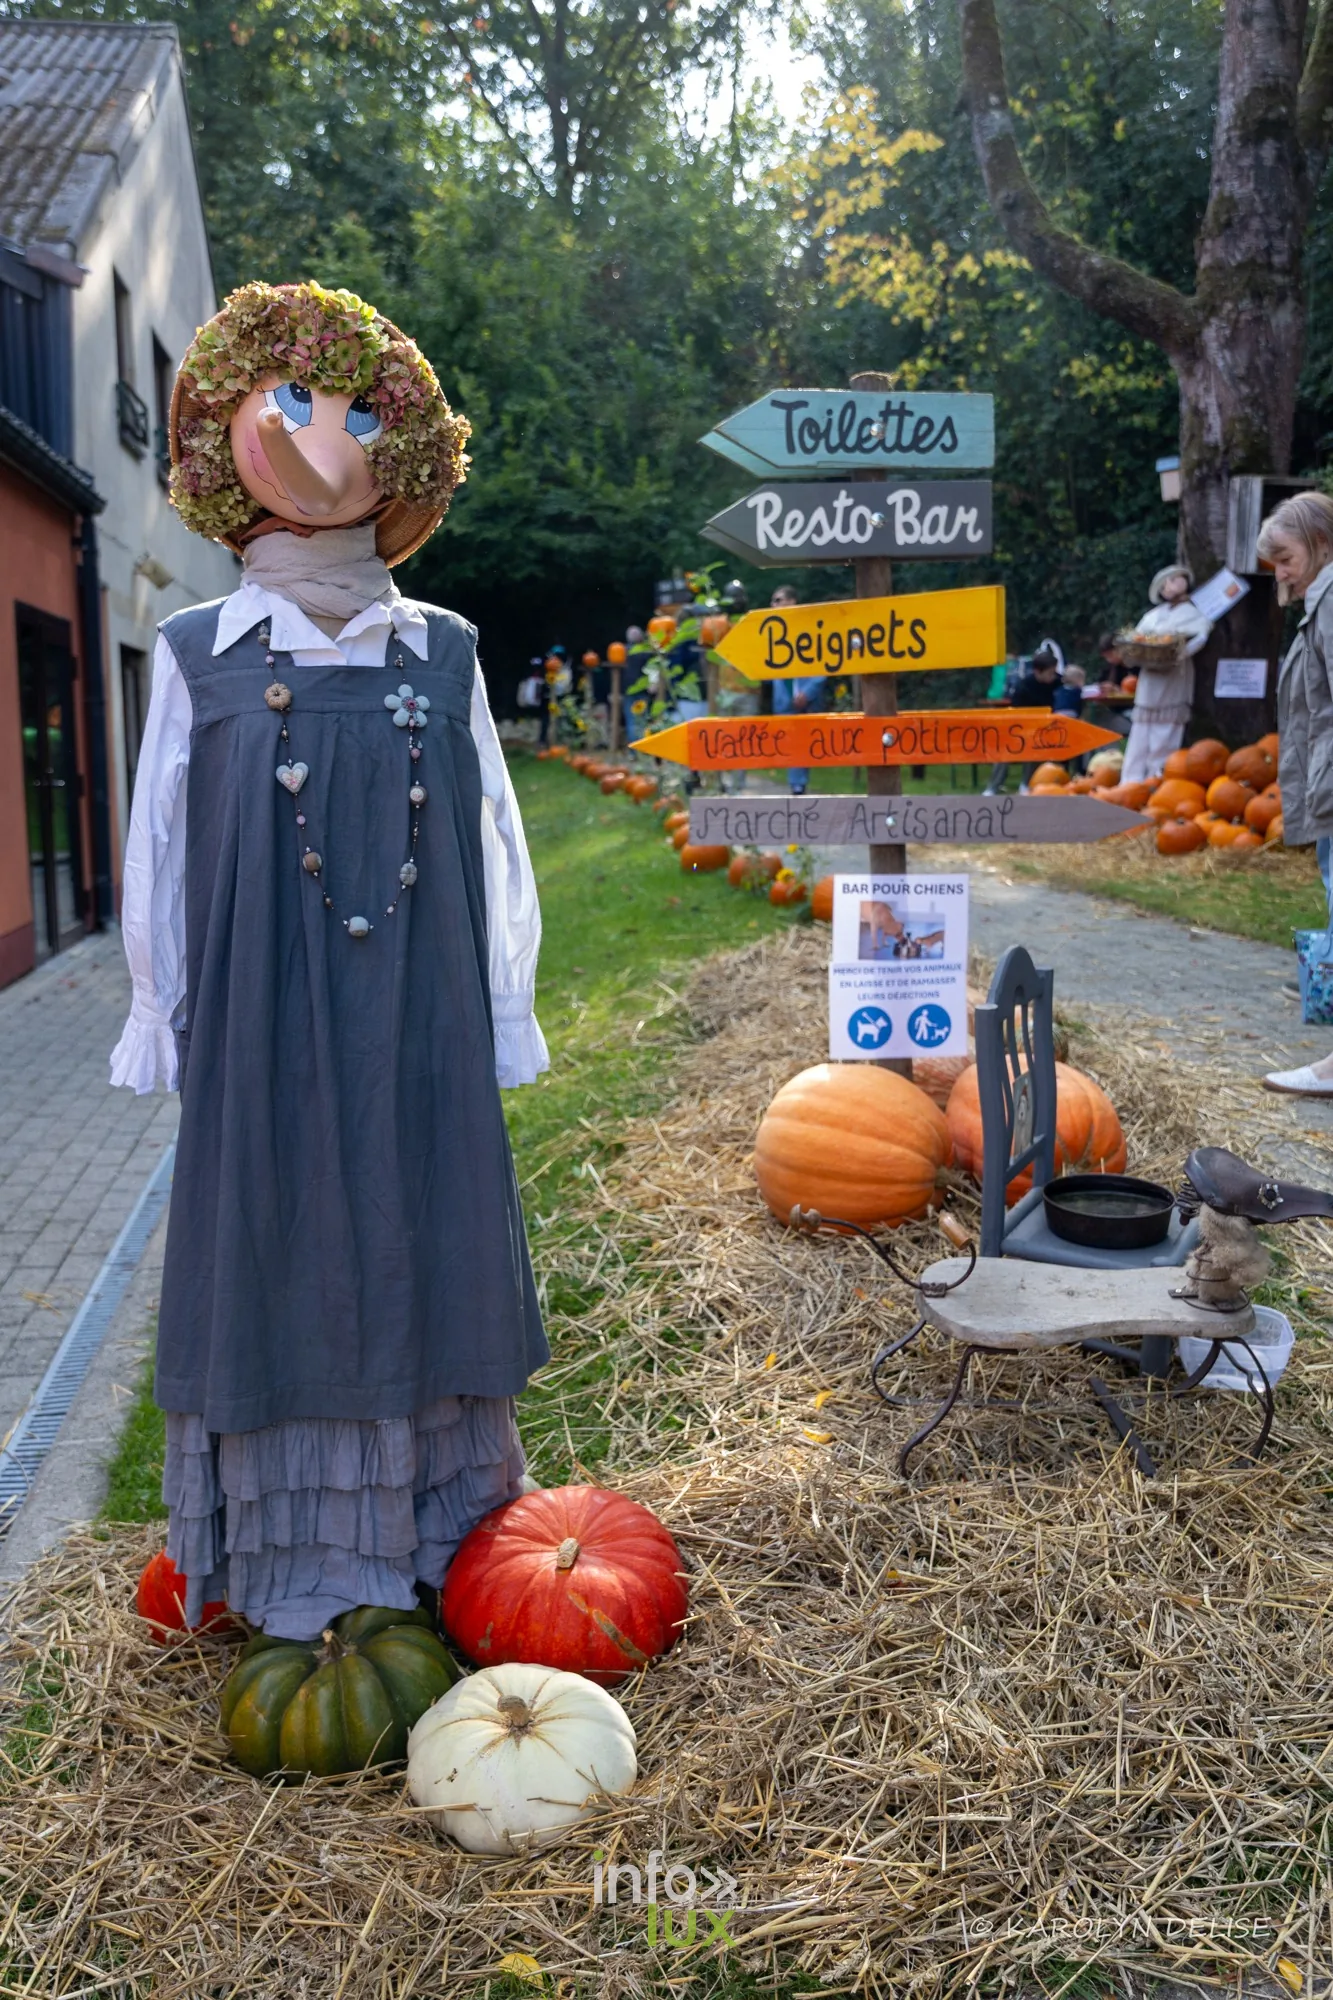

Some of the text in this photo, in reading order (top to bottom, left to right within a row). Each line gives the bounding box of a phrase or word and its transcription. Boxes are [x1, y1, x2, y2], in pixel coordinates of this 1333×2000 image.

[770, 399, 959, 455] Toilettes
[747, 488, 984, 550] Resto Bar
[759, 609, 927, 673] Beignets
[809, 727, 864, 760] aux
[881, 719, 1026, 764] potirons
[696, 797, 1018, 841] Marché Artisanal
[842, 883, 964, 895] BAR POUR CHIENS
[840, 980, 852, 989] EN
[886, 979, 896, 987] ET
[898, 978, 910, 987] DE
[877, 965, 902, 975] TENIR
[904, 965, 922, 974] VOS
